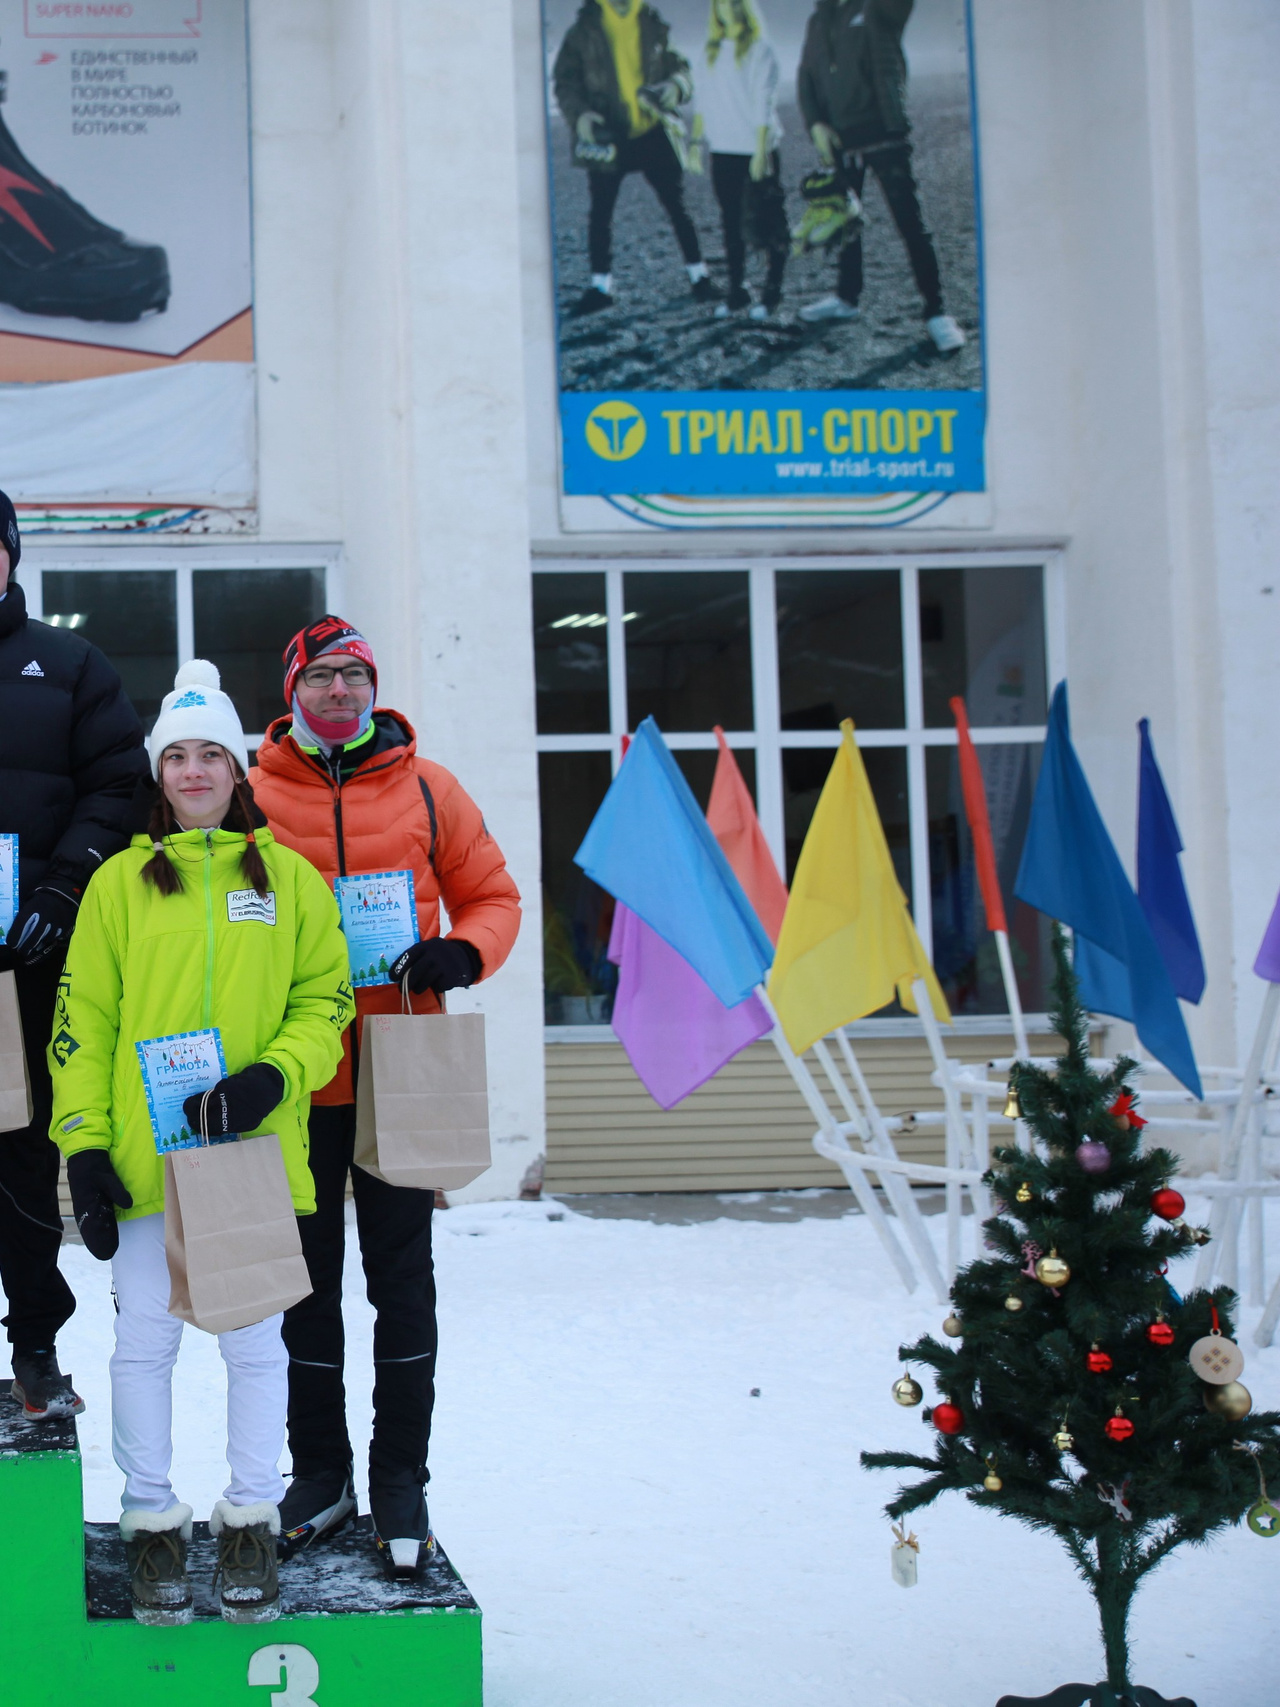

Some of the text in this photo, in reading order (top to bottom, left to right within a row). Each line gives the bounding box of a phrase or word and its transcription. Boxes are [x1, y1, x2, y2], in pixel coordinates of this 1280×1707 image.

[71, 49, 198, 66] ЕДИНСТВЕННЫЙ
[71, 69, 128, 82] В МИРЕ
[71, 86, 174, 99] ПОЛНОСТЬЮ
[71, 102, 182, 117] КАРБОНОВЫЙ
[71, 122, 148, 135] БОТИНОК
[775, 457, 956, 481] www.trial-sport.ru
[21, 669, 45, 678] adidas
[350, 901, 401, 914] ГРАМОТА
[156, 1059, 210, 1076] ГРАМОТА
[220, 1092, 228, 1132] NORDSKI
[248, 1644, 321, 1707] 3
